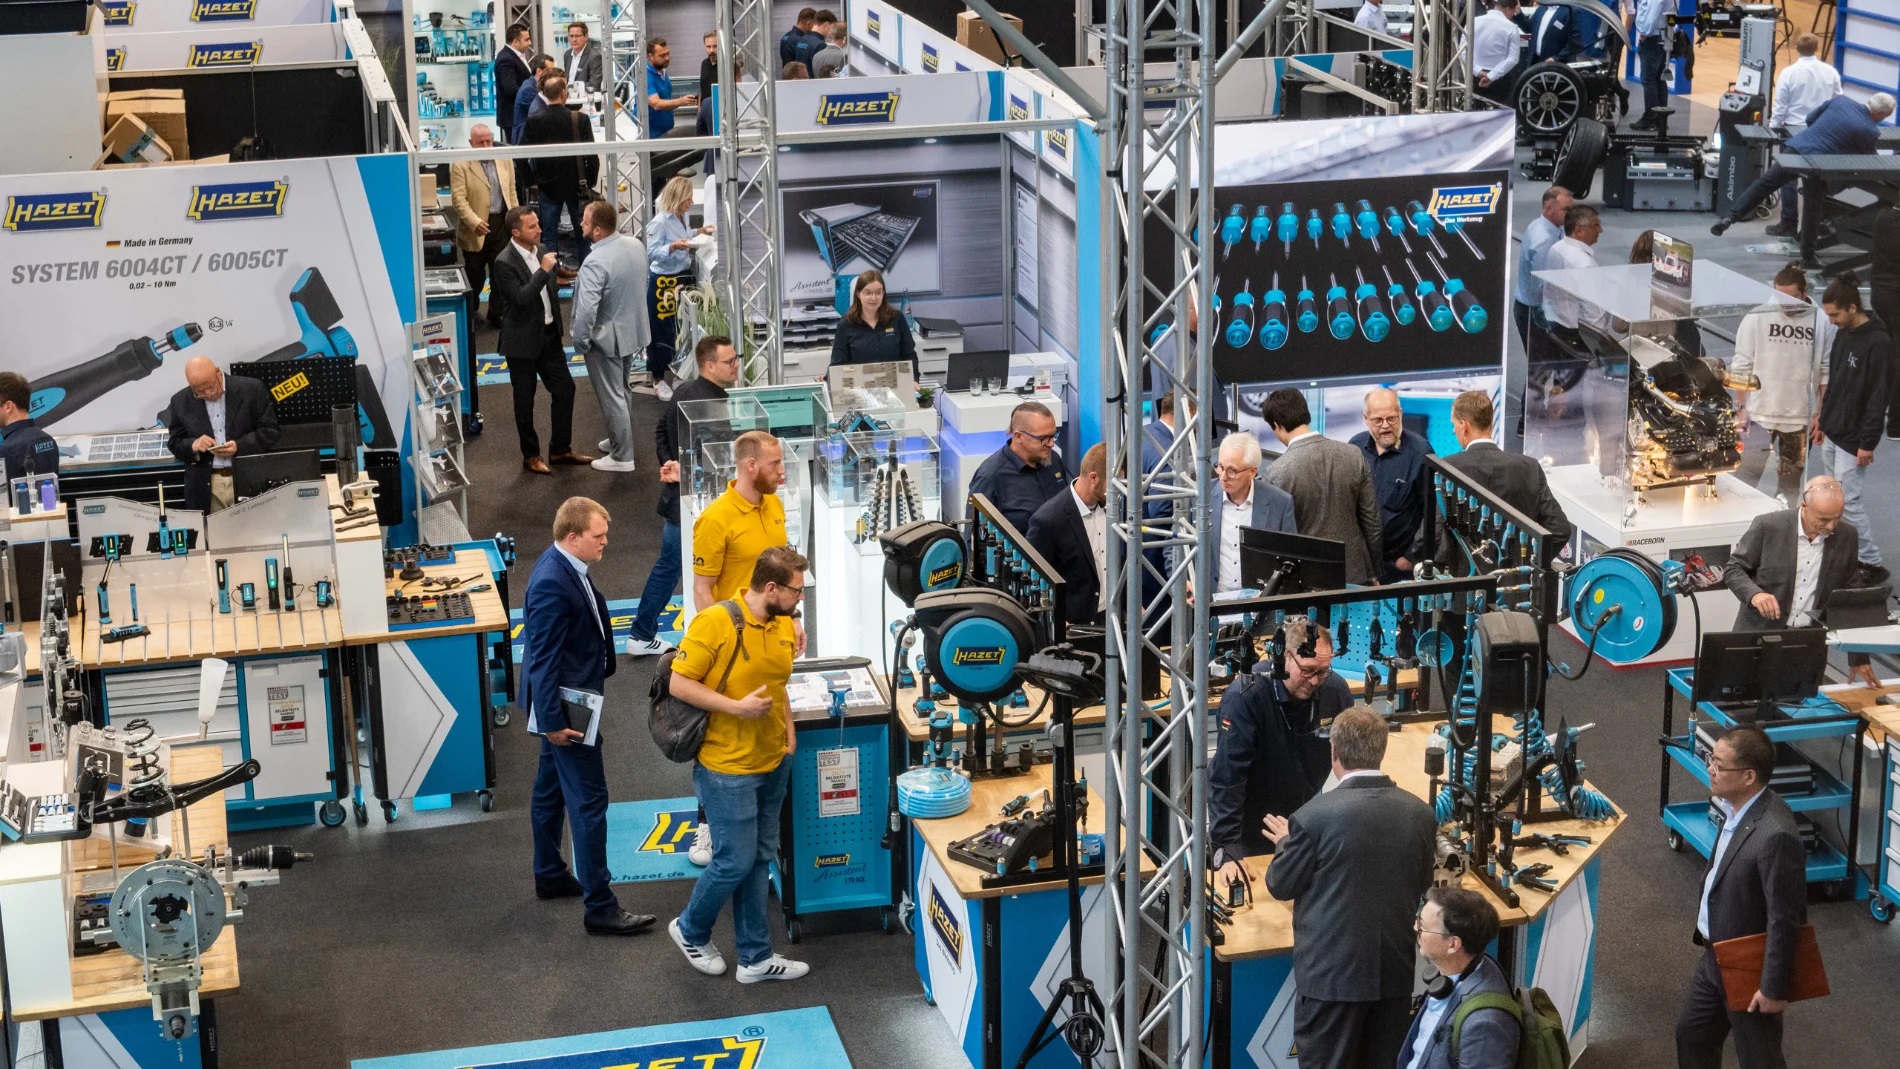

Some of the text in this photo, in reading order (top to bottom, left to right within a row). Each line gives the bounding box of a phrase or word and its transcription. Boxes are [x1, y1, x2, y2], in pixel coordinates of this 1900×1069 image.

[197, 2, 250, 16] HAZET
[195, 49, 254, 65] HAZET
[824, 100, 891, 118] HAZET
[1048, 128, 1067, 150] HAZET
[1726, 155, 1736, 201] Akimbo
[198, 190, 279, 212] HAZET
[1436, 193, 1493, 209] HAZET
[14, 201, 96, 223] HAZET
[123, 237, 193, 248] Made in Germany
[11, 248, 289, 285] SYSTEM 6004CT / 6005CT
[129, 282, 145, 290] 0,02
[153, 281, 163, 289] 10
[164, 280, 177, 288] Nm
[1230, 334, 1245, 342] PZ1
[1265, 334, 1282, 344] PZ2
[1768, 323, 1815, 341] BOSS
[273, 376, 306, 399] NEU!
[1632, 537, 1665, 546] RACEBORN
[931, 565, 957, 582] HAZET
[959, 650, 1000, 662] HAZET
[268, 692, 287, 700] TEST
[820, 758, 839, 766] TEST
[817, 856, 847, 866] HAZET
[611, 871, 685, 882] w.hazet.de
[931, 898, 960, 953] HAZET
[984, 923, 992, 948] HAZET
